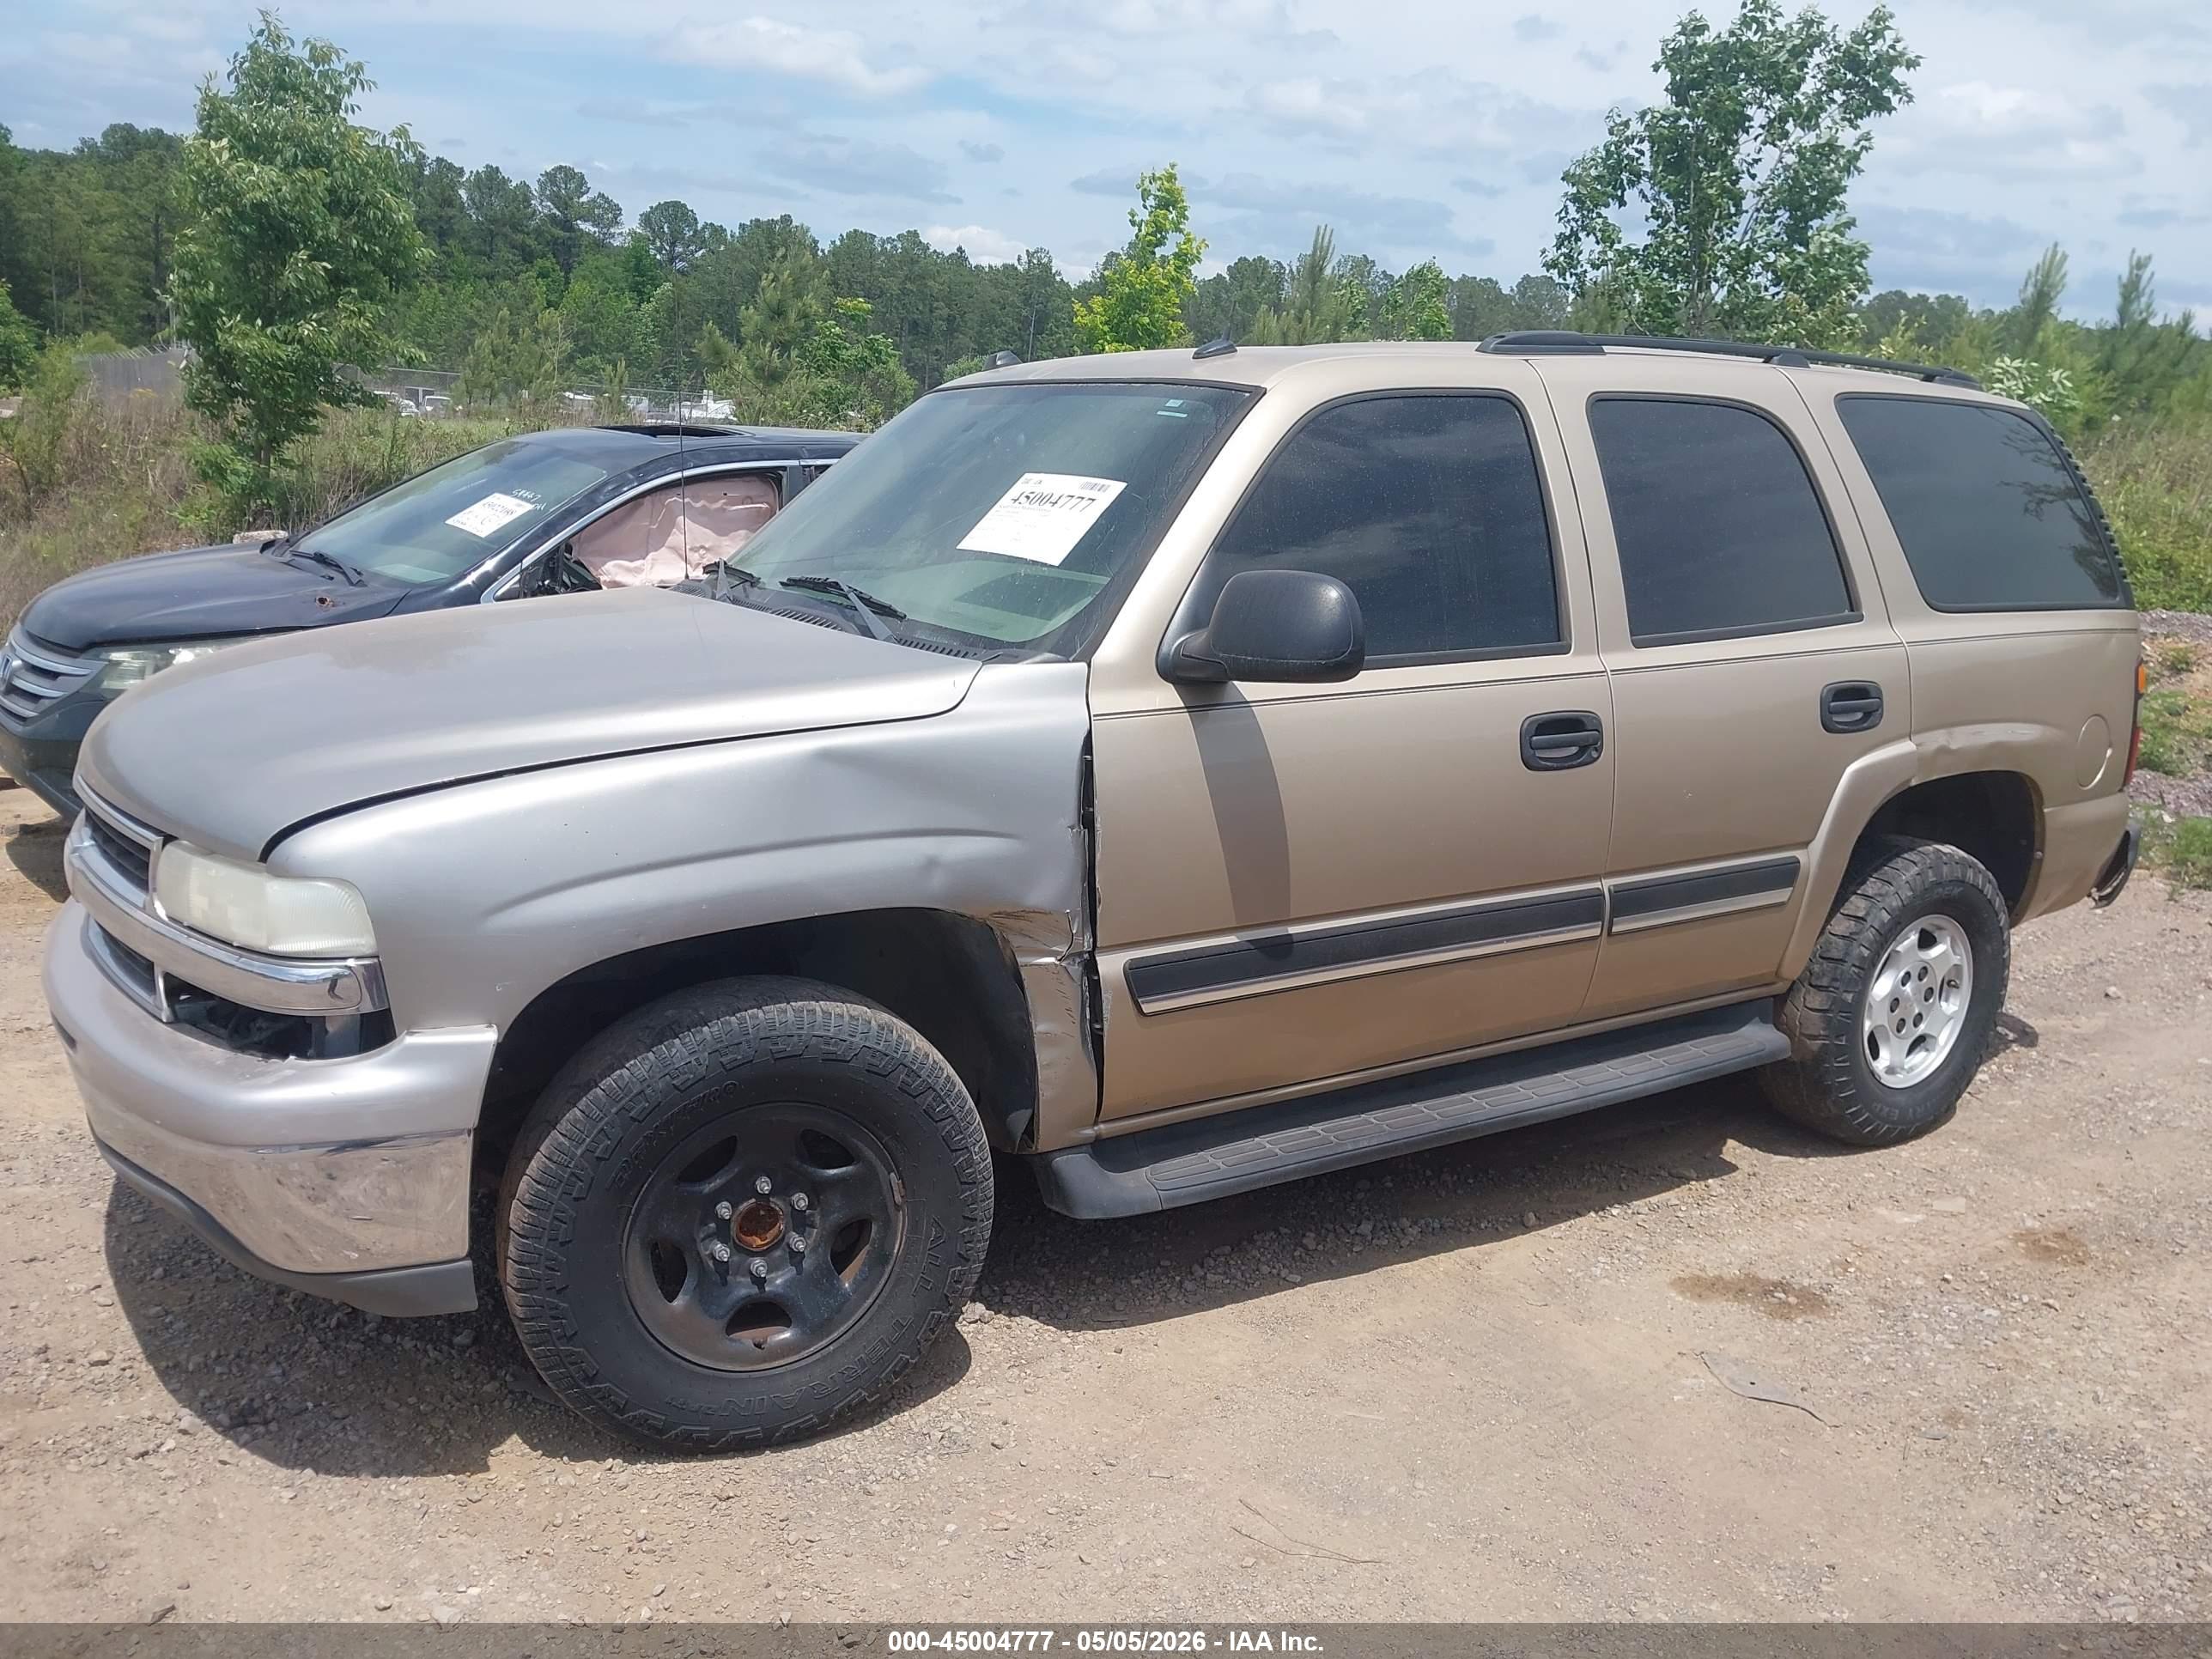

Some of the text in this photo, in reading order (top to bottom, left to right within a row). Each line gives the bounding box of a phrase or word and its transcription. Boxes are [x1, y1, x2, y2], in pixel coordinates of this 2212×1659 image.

[1011, 491, 1097, 513] 45004777
[720, 1215, 945, 1416] ALL TERRAIN
